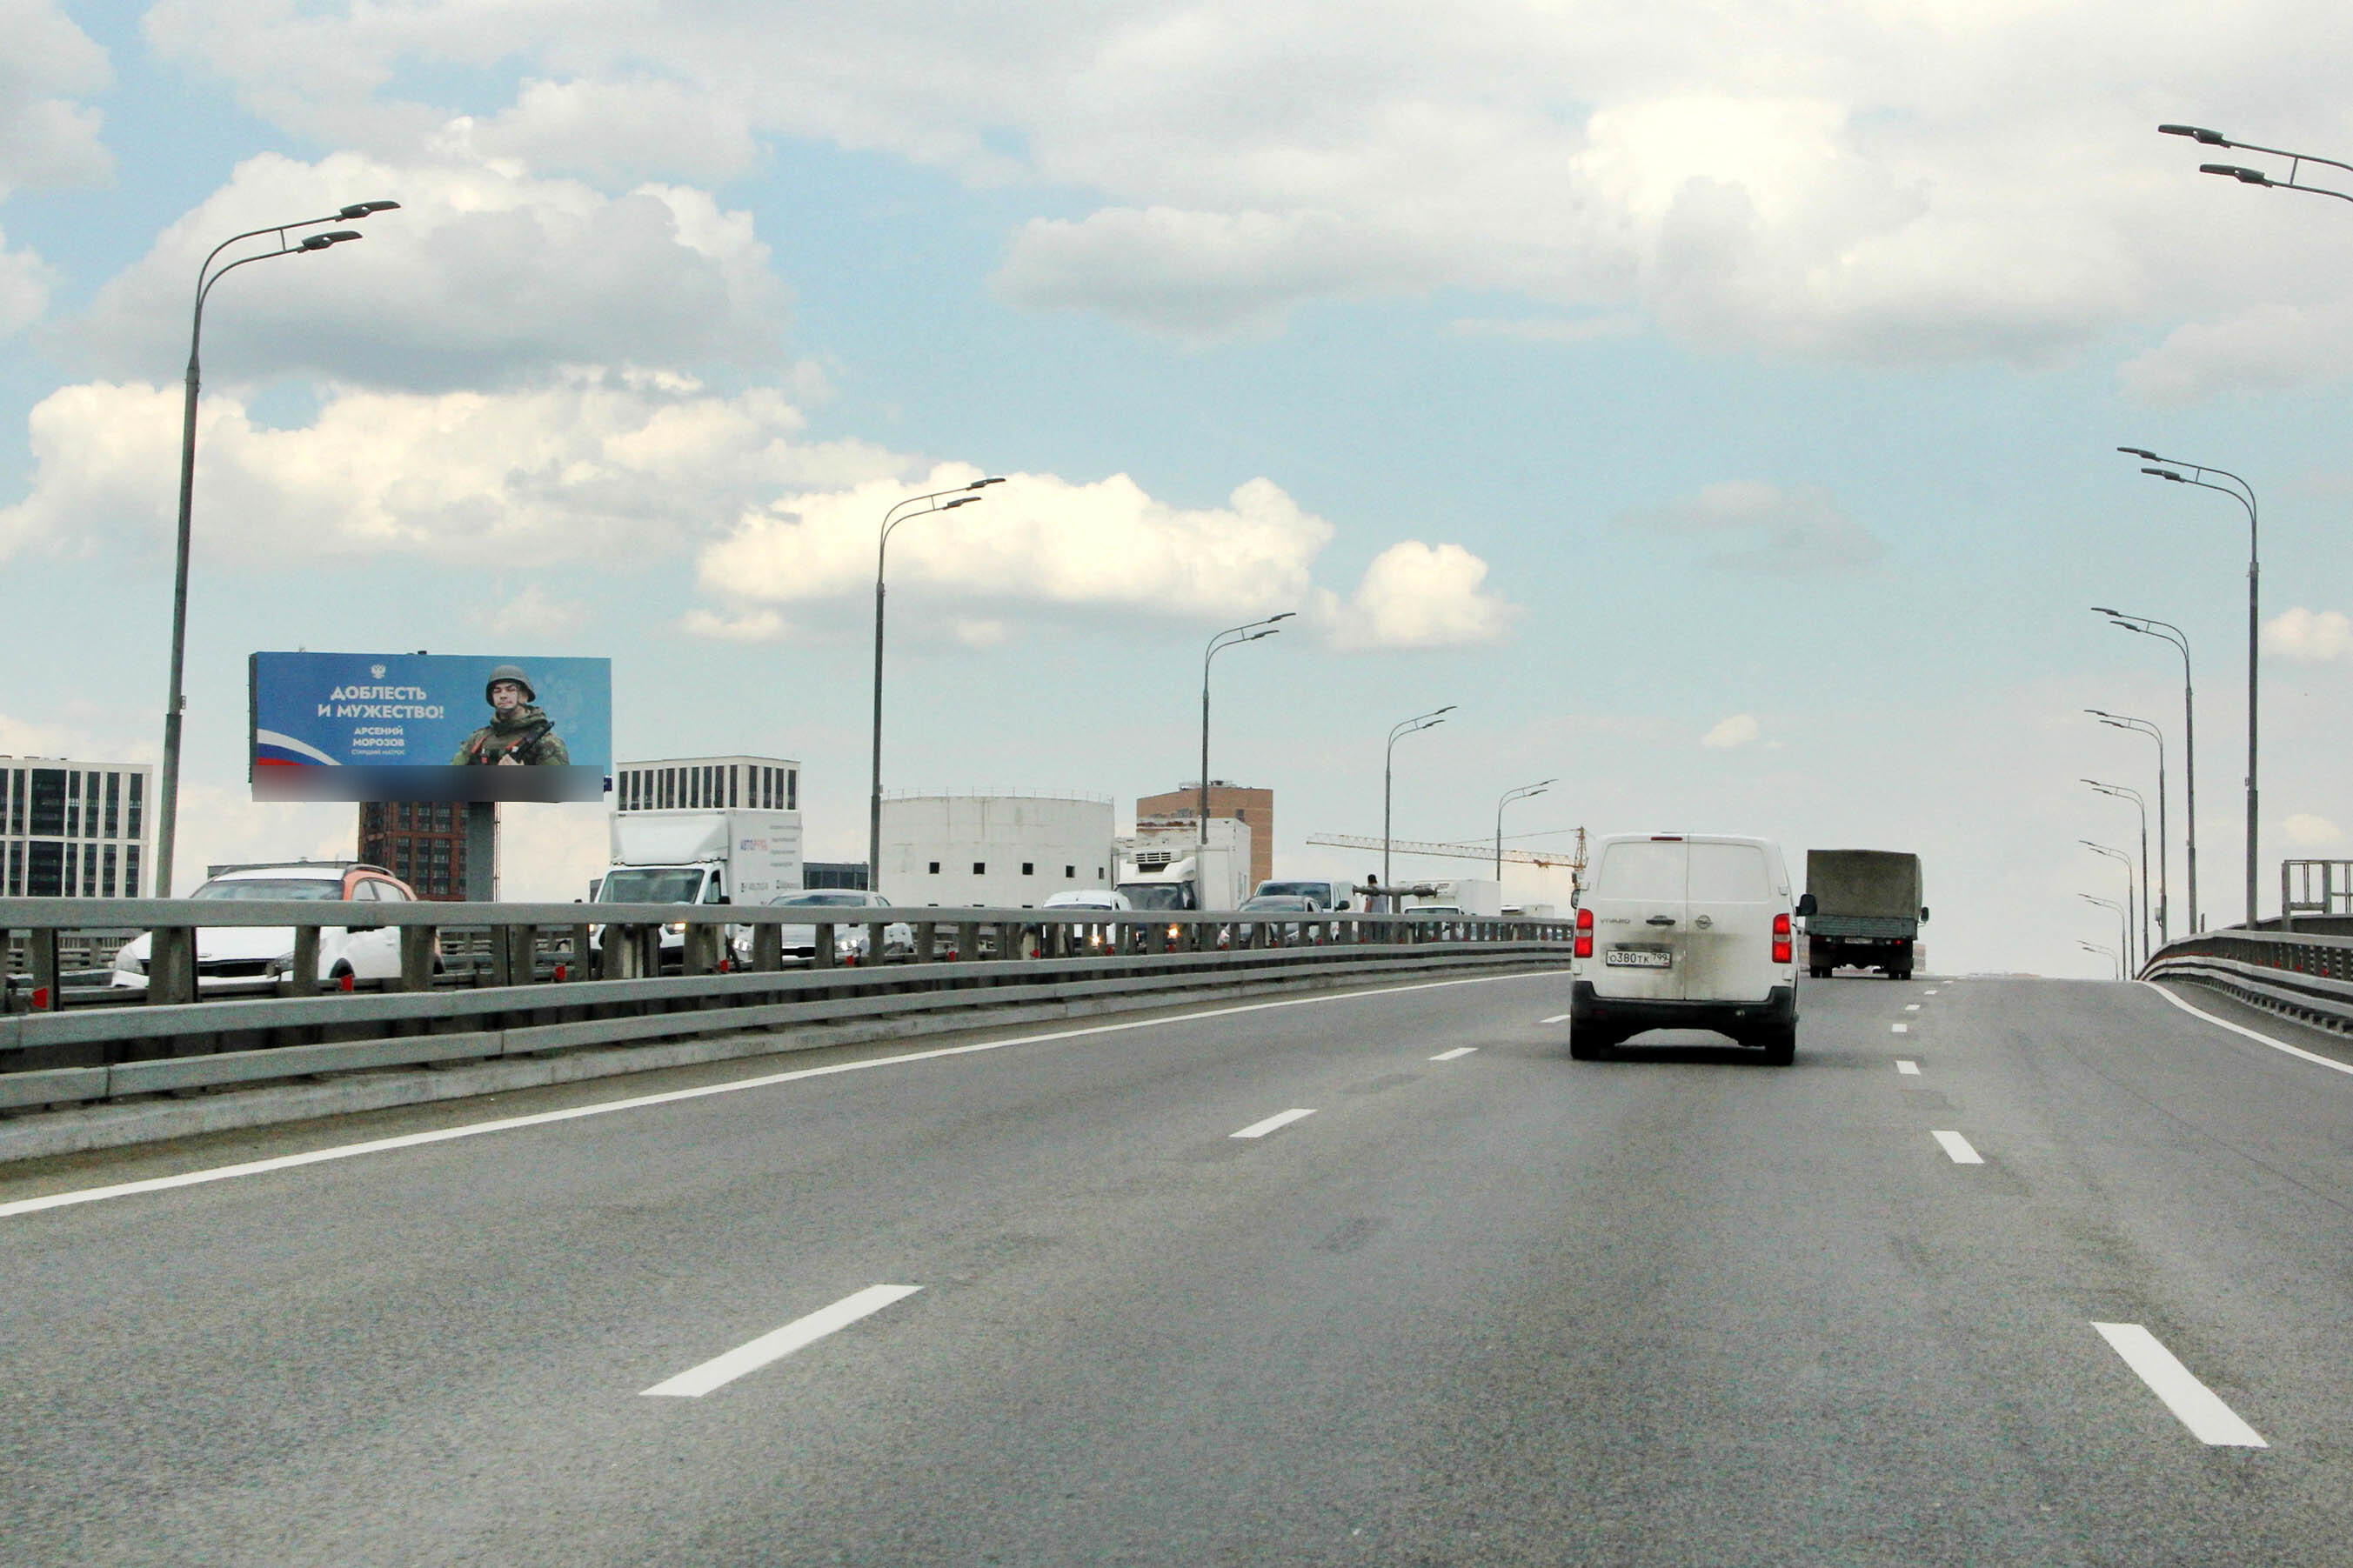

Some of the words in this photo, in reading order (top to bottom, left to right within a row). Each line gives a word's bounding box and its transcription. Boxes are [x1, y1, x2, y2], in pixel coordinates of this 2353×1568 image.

[331, 686, 426, 700] ДОБЛЕСТЬ
[318, 704, 331, 717] И
[337, 704, 445, 719] МУЖЕСТВО!
[355, 726, 404, 736] АРСЕНИЙ
[352, 737, 404, 747] МОРОЗОВ
